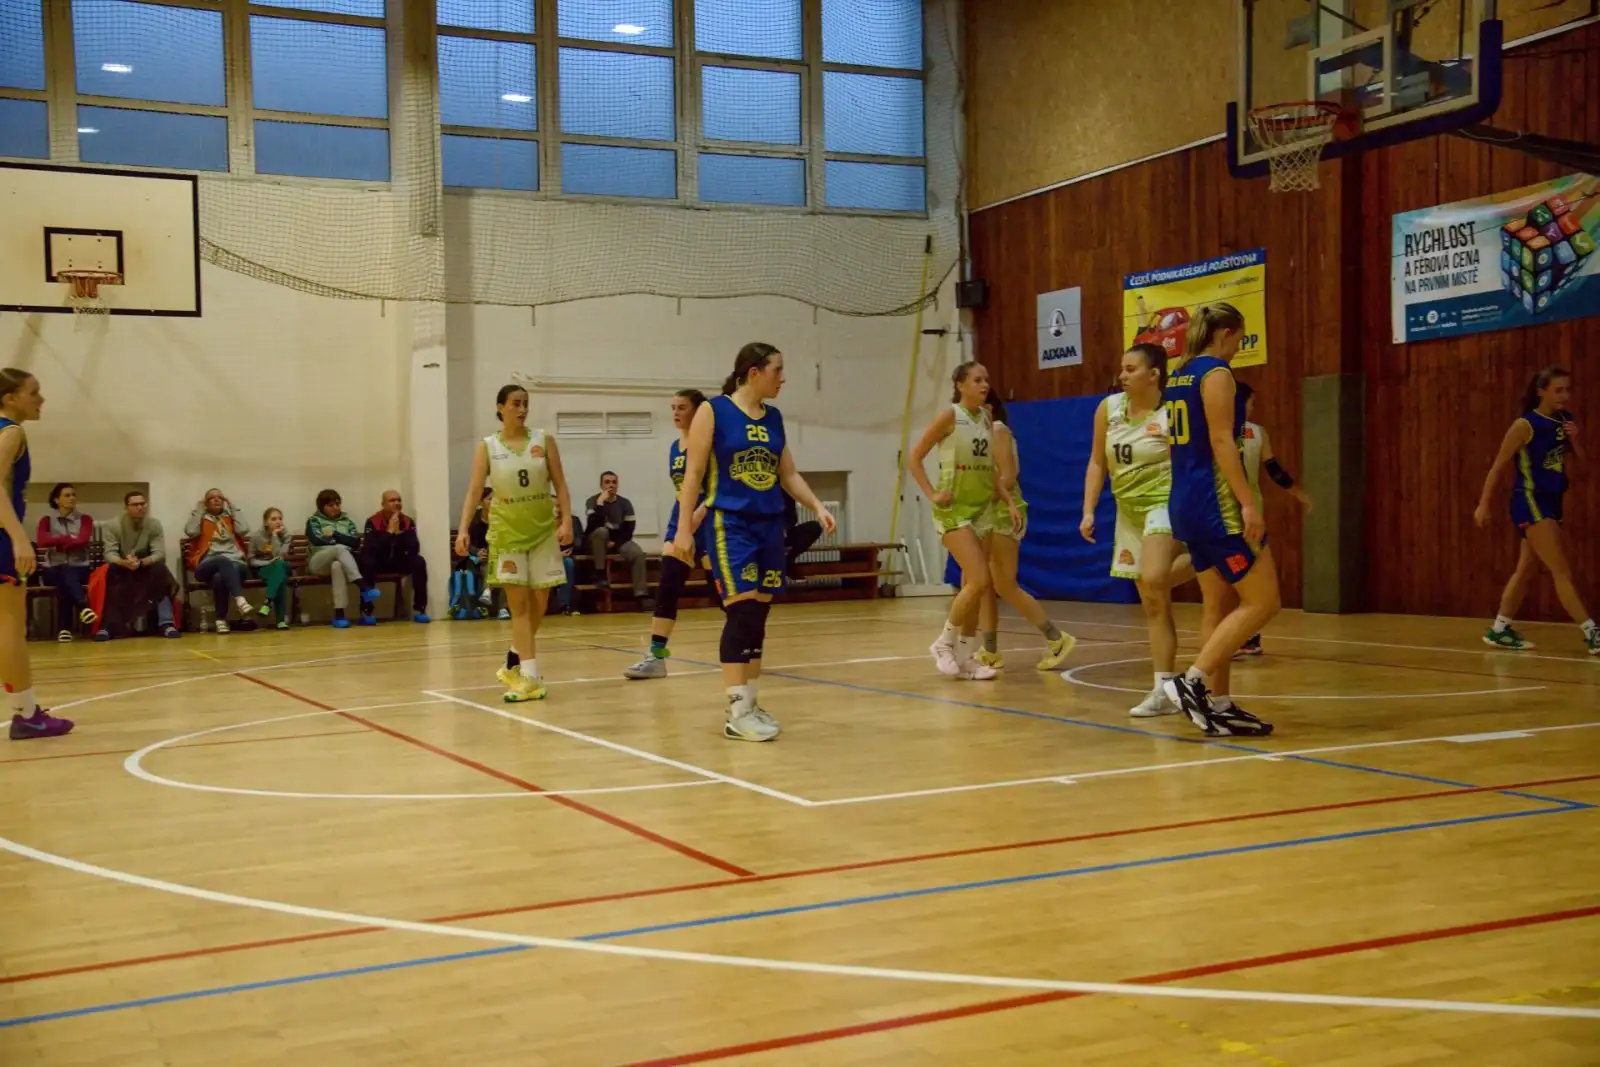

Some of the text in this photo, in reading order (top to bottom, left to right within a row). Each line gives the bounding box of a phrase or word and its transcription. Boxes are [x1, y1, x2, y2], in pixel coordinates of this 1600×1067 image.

[1405, 221, 1475, 257] RYCHLOST
[1405, 261, 1412, 278] A
[1453, 249, 1481, 268] CENA
[1405, 279, 1416, 294] NA
[1241, 333, 1258, 350] PP
[1042, 345, 1077, 361] AIXAM
[745, 424, 770, 442] 26
[1556, 426, 1565, 440] 3
[972, 438, 989, 457] 32
[1113, 443, 1132, 465] 19
[672, 455, 685, 469] 33
[731, 462, 759, 476] SOKOL
[518, 469, 530, 487] 8
[762, 569, 782, 588] 26
